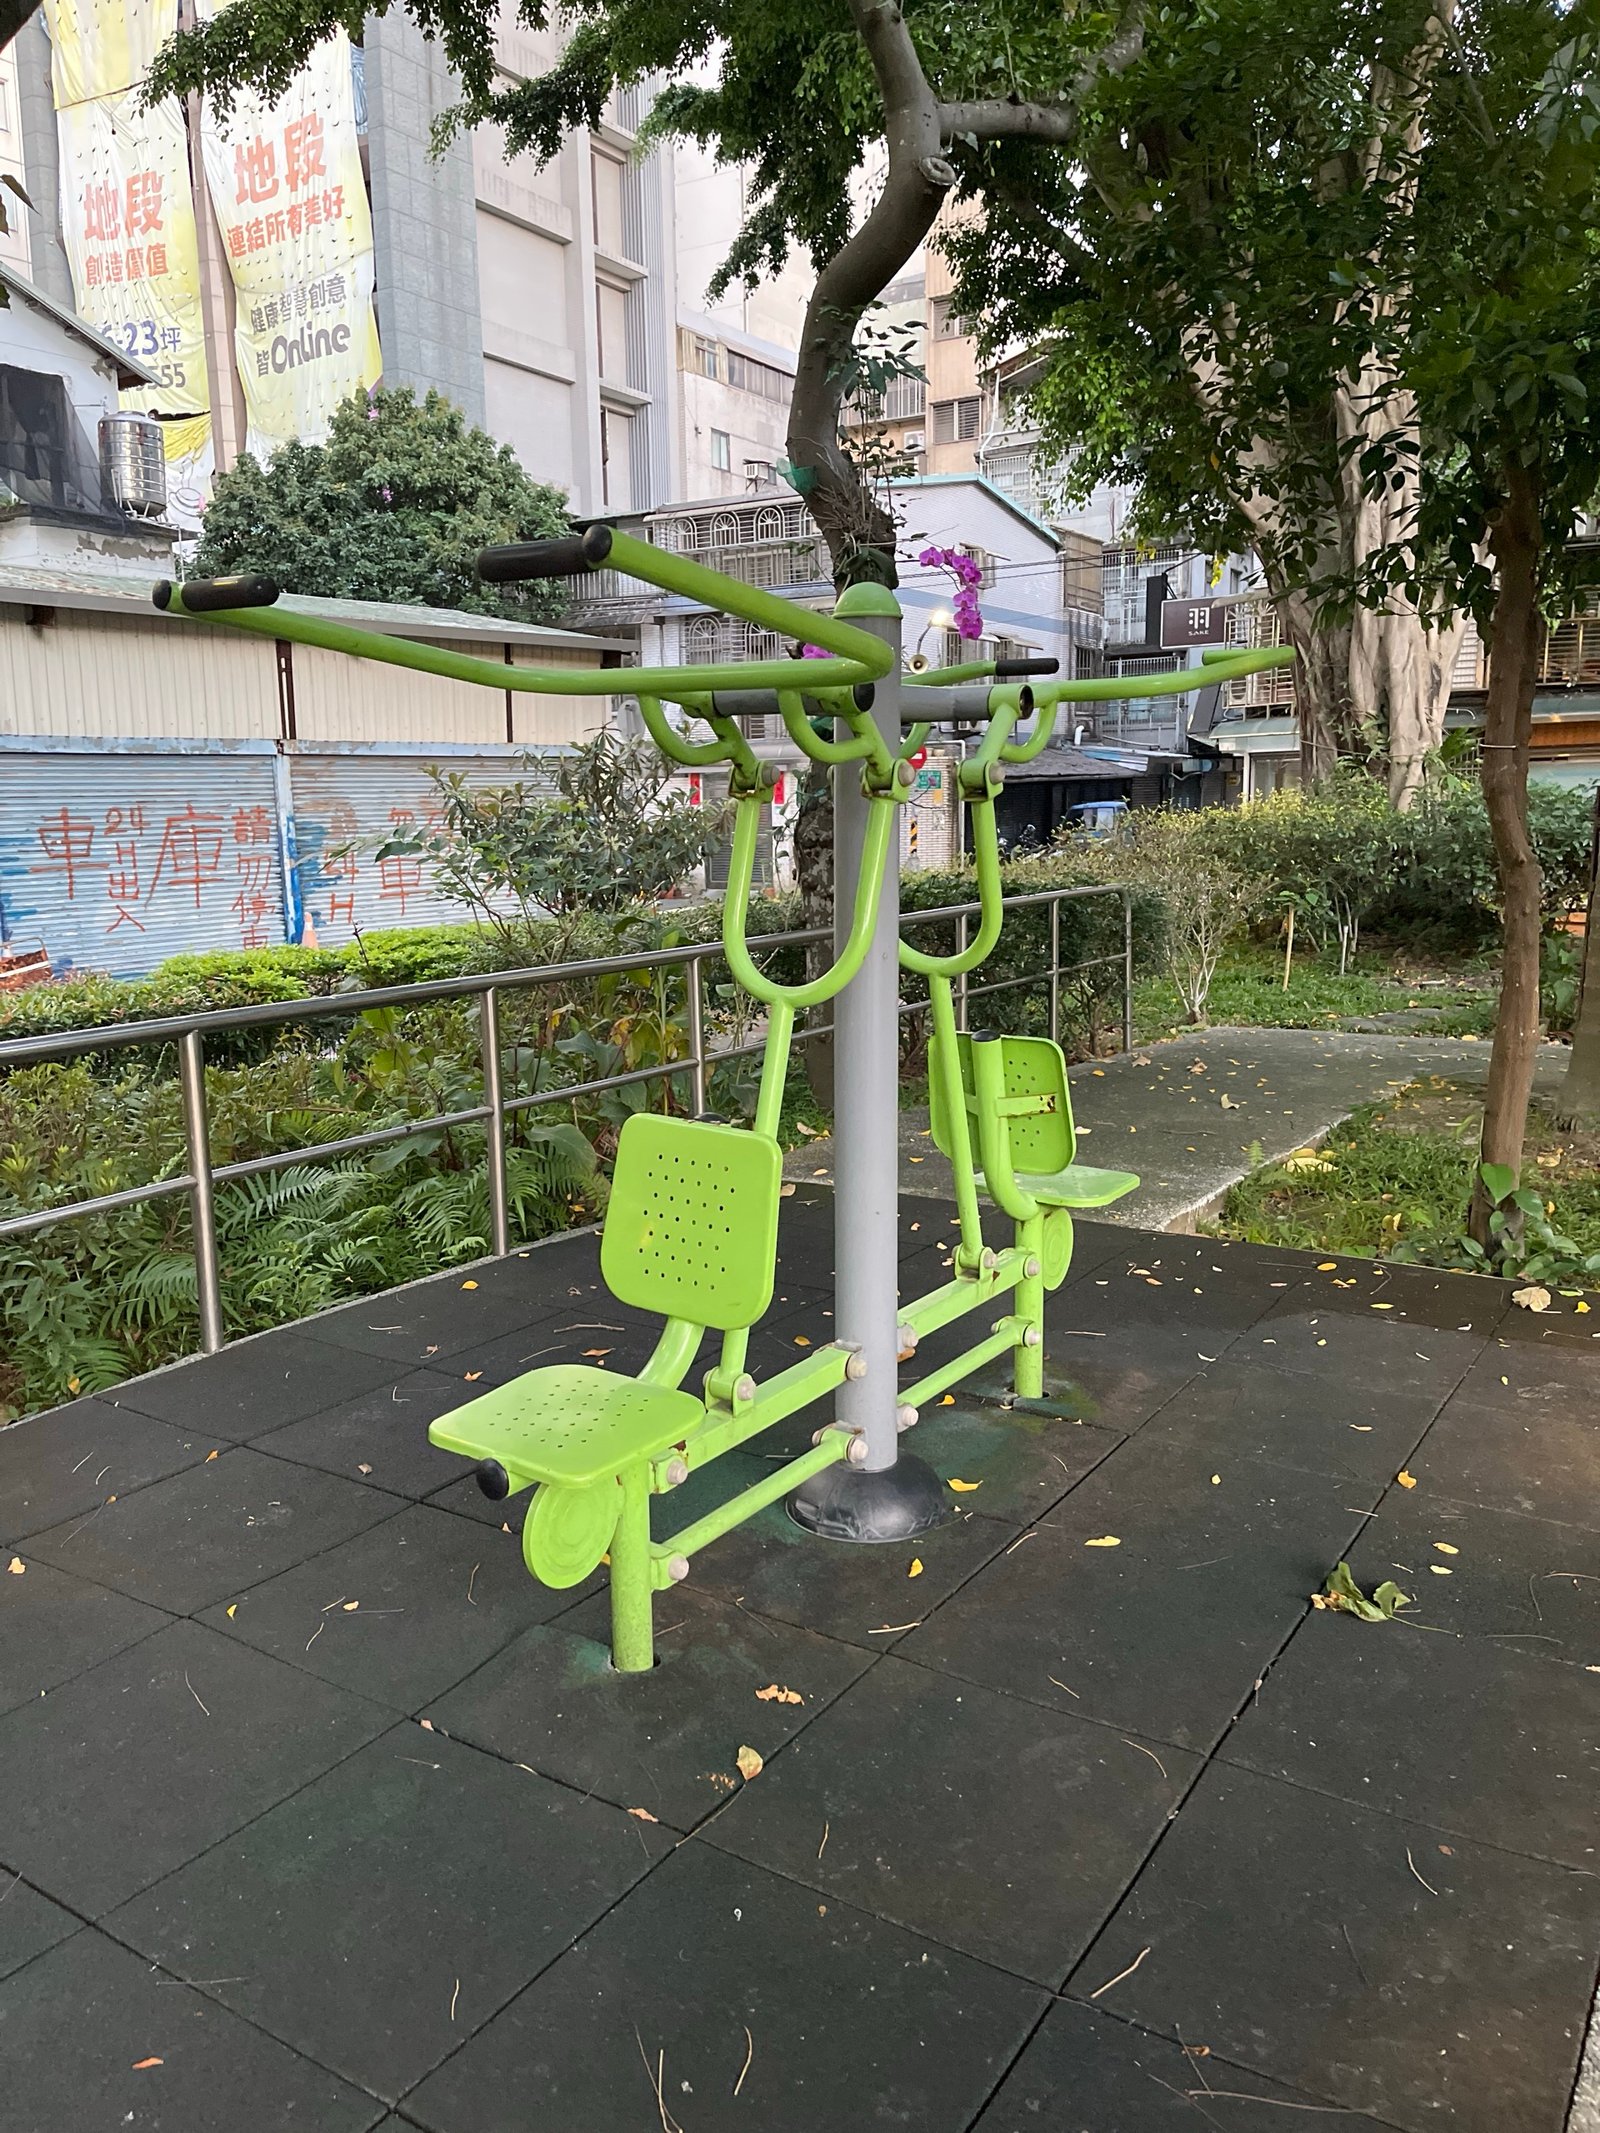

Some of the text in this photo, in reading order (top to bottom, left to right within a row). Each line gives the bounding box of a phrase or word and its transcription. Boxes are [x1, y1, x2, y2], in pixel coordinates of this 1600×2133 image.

[234, 112, 327, 205] 地段
[84, 170, 164, 241] 地段
[227, 185, 345, 258] 連結所有美好
[86, 242, 169, 286] 創造價值
[251, 275, 347, 336] 健康智慧創意
